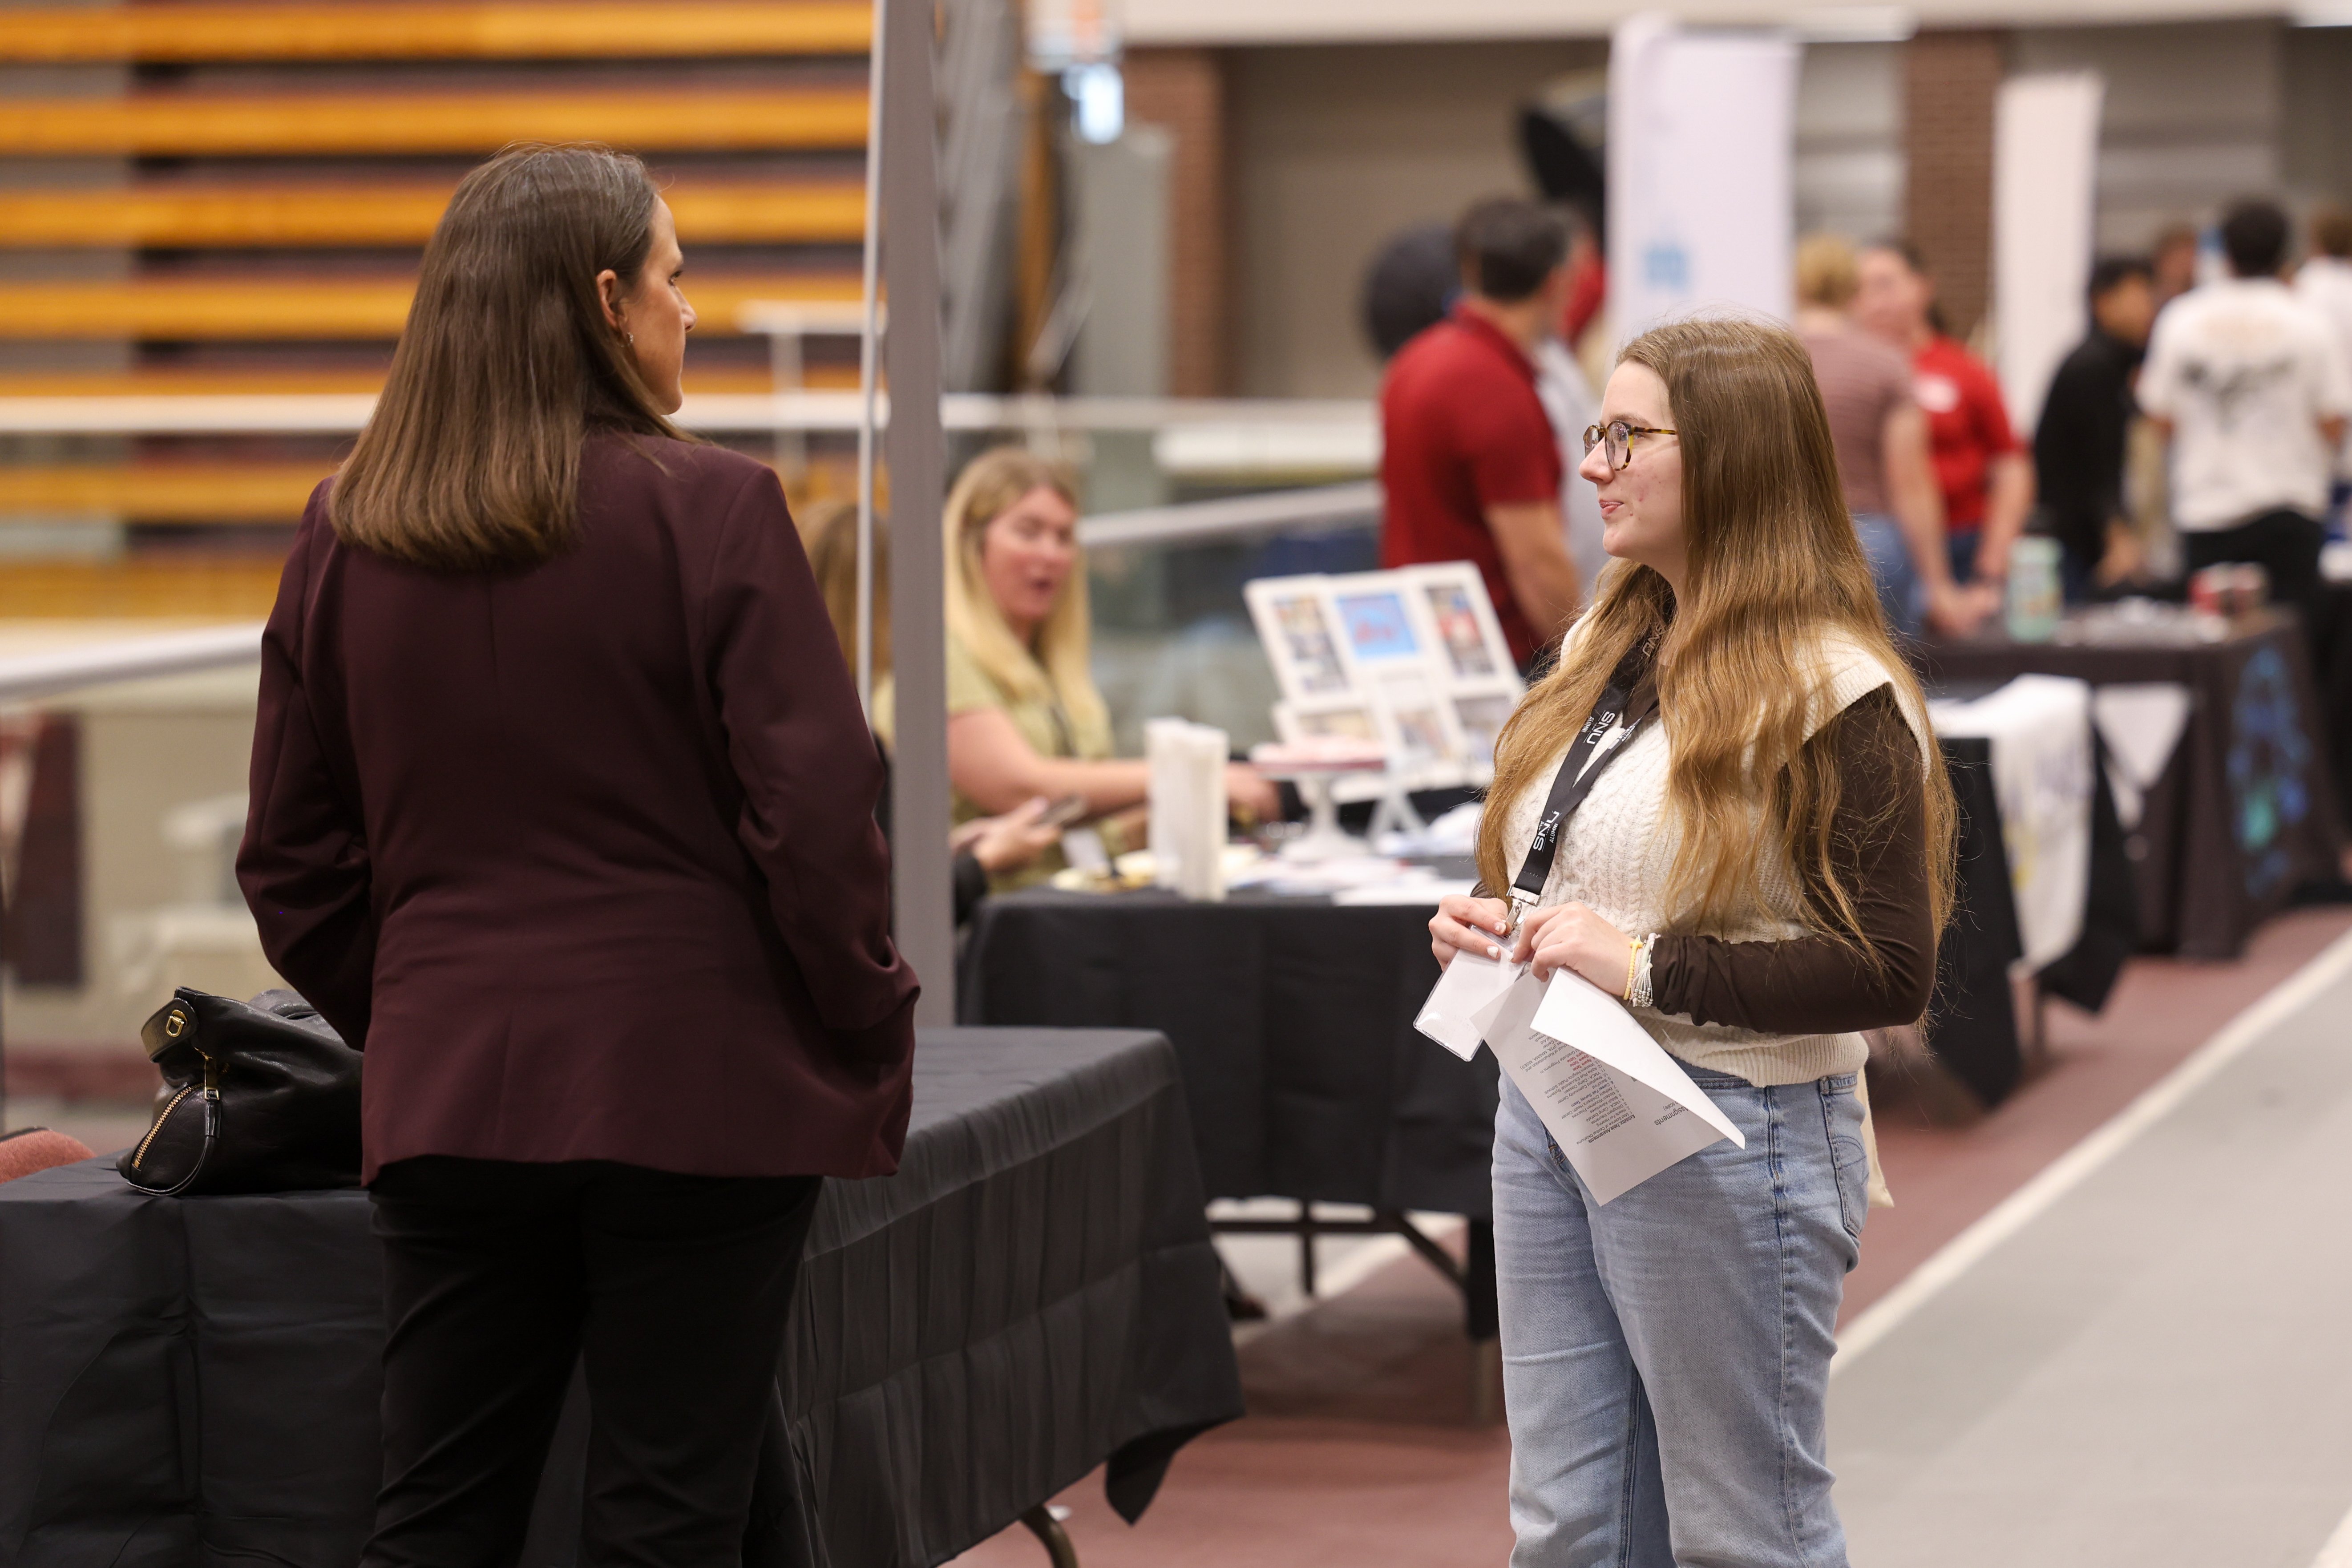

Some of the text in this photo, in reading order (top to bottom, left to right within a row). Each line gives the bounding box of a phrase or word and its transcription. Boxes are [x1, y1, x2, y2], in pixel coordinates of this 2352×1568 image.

[1581, 715, 1594, 733] ALUMNI
[1586, 711, 1615, 744] SNU
[1549, 823, 1559, 844] ALUMNI
[1543, 1040, 1554, 1049] Center
[1560, 1051, 1575, 1061] Graduate
[1544, 1060, 1560, 1071] Programs
[1561, 1077, 1580, 1090] Educational
[1587, 1075, 1603, 1086] Shepherd
[1544, 1084, 1558, 1094] Schools
[1564, 1084, 1577, 1094] Classen
[1568, 1084, 1587, 1096] Community
[1599, 1083, 1610, 1091] Career
[1547, 1088, 1561, 1099] Systems
[1580, 1093, 1592, 1101] Survey
[1557, 1095, 1569, 1104] Center
[1589, 1101, 1608, 1113] Adventures
[1663, 1102, 1675, 1111] scale)
[1561, 1111, 1572, 1119] Center
[1591, 1114, 1607, 1124] Insurance
[1620, 1114, 1635, 1125] Exhibitor
[1608, 1116, 1621, 1125] Science
[1588, 1128, 1610, 1143] Assignments
